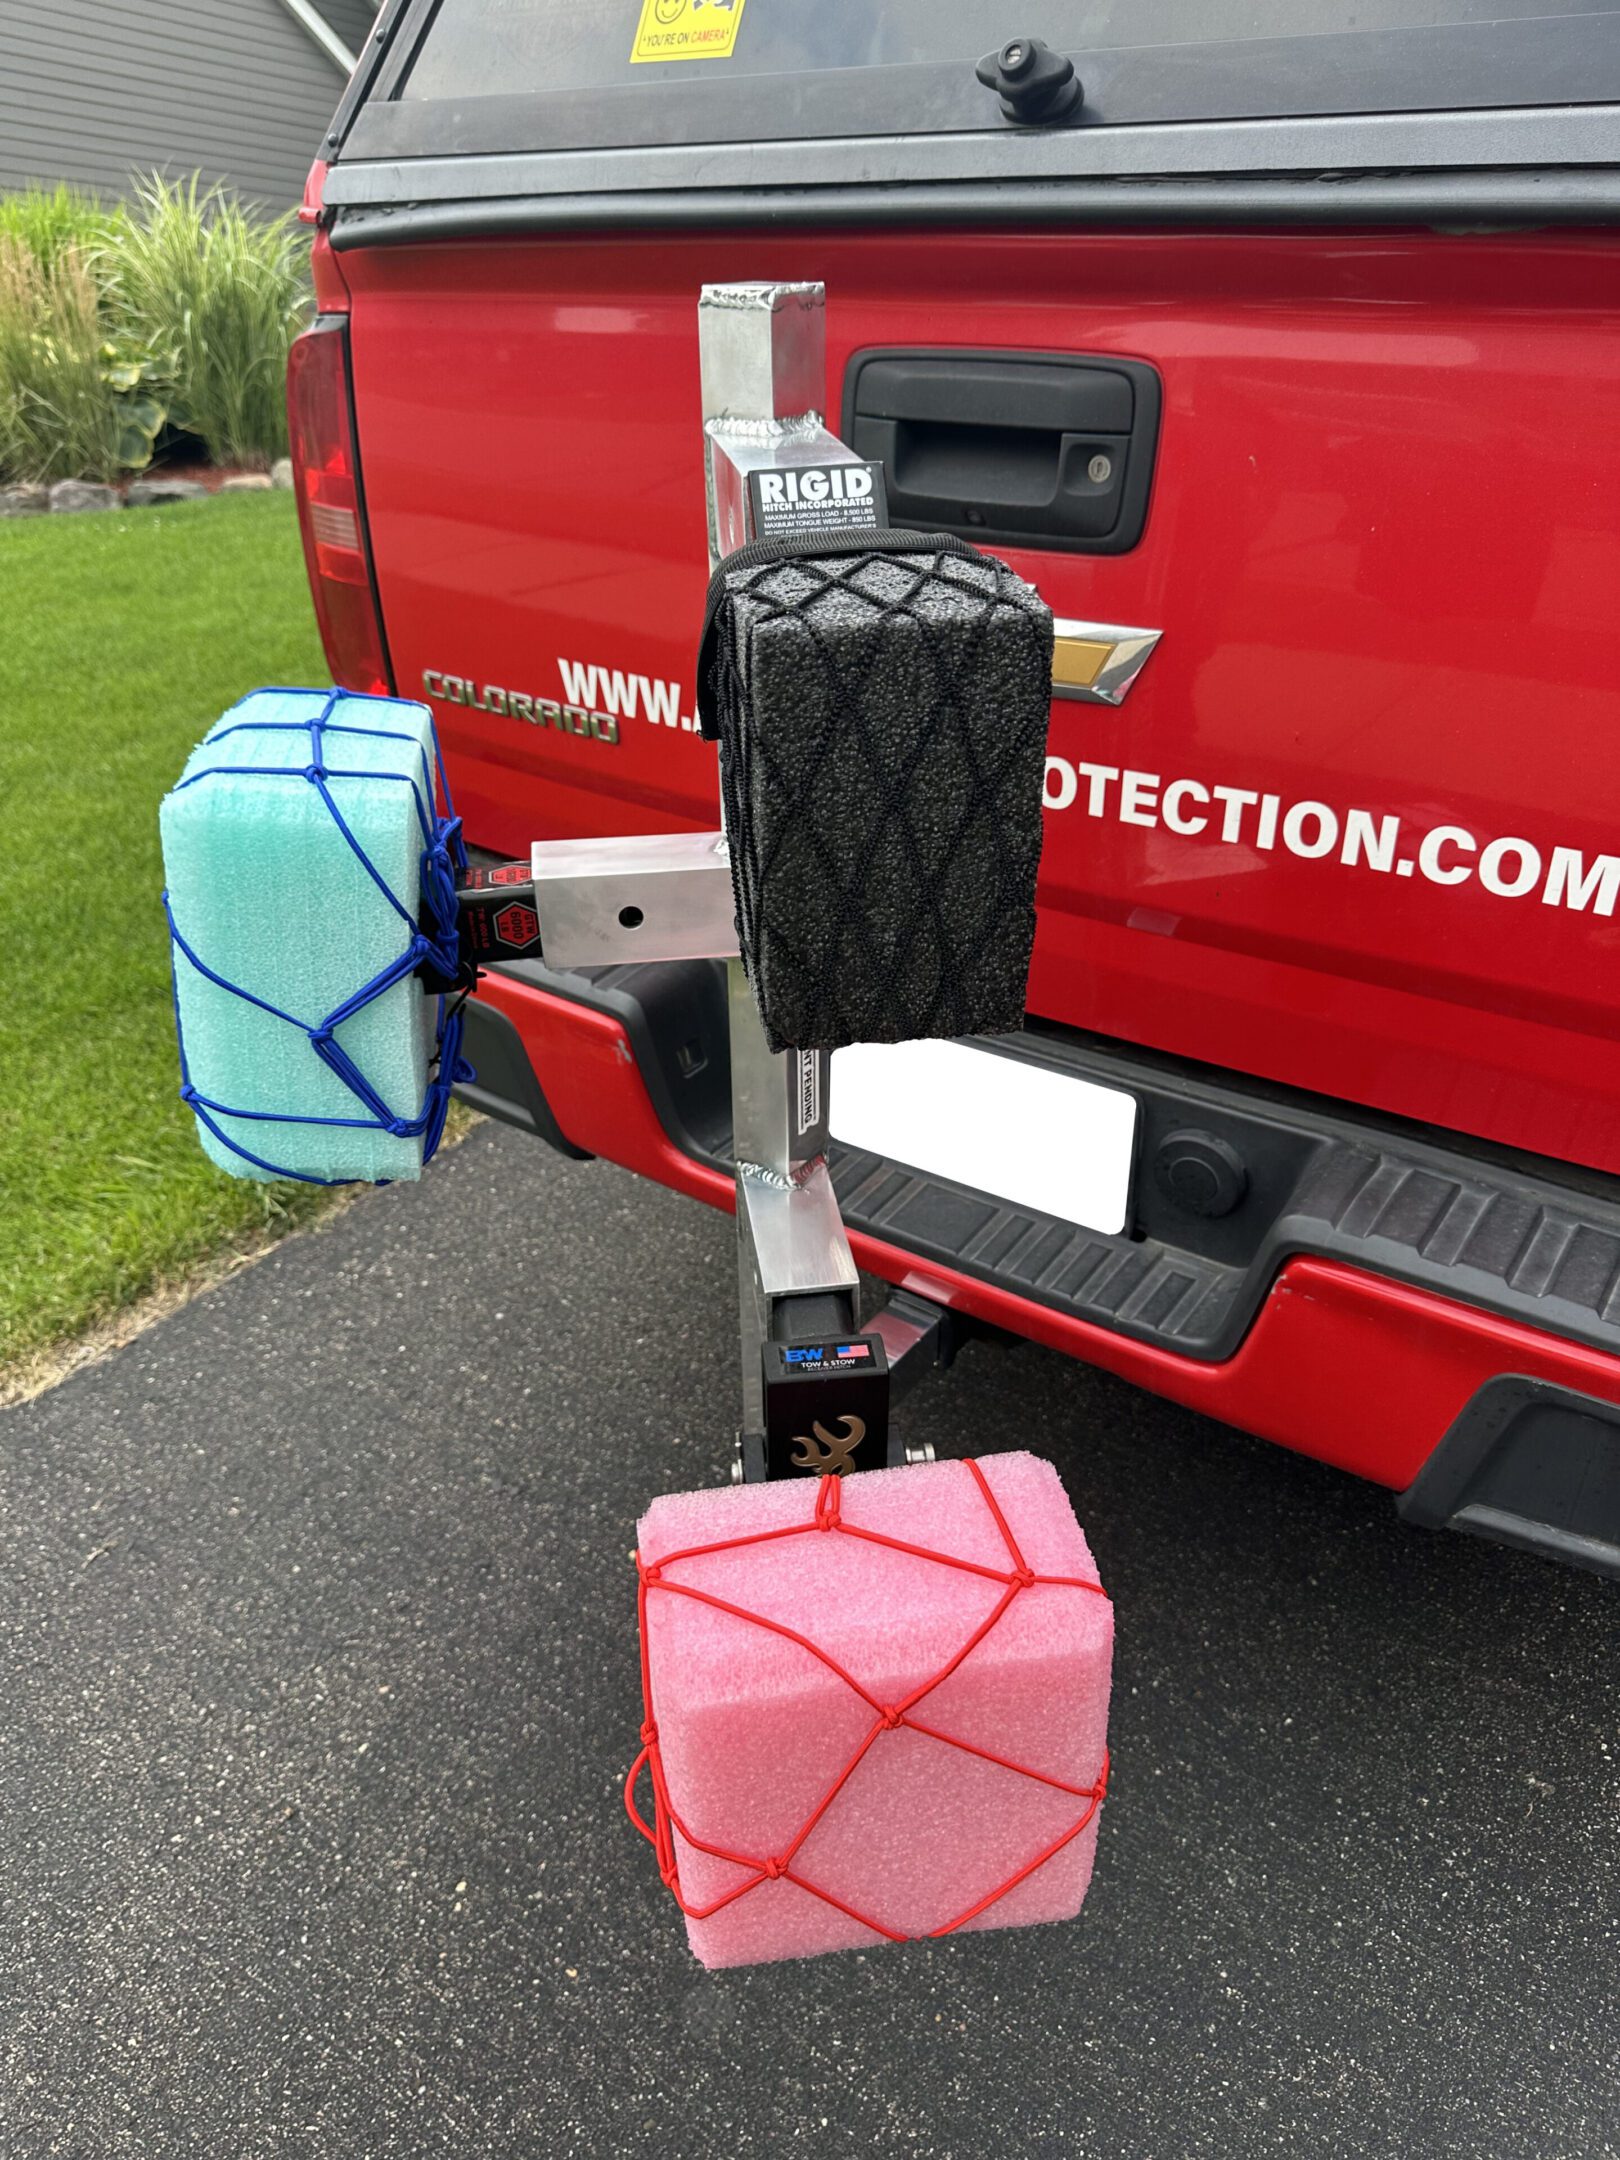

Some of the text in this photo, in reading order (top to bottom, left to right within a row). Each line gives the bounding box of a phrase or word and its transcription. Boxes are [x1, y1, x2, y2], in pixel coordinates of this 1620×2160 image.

[677, 33, 689, 45] ON
[759, 468, 873, 503] RIGID
[762, 497, 874, 512] HITCH INCORPORATED
[765, 513, 796, 522] MAXIMUM
[797, 511, 820, 520] GROSS
[821, 509, 839, 518] LOAD
[860, 507, 873, 515] LBS
[764, 520, 795, 529] MAXIMUM
[795, 518, 821, 527] TONGUE
[822, 516, 848, 525] WEIGHT
[773, 528, 785, 536] NOT
[557, 657, 702, 733] WWW.
[422, 669, 620, 745] COLORADO
[804, 1069, 813, 1124] PENDING
[801, 1361, 821, 1369] TOW
